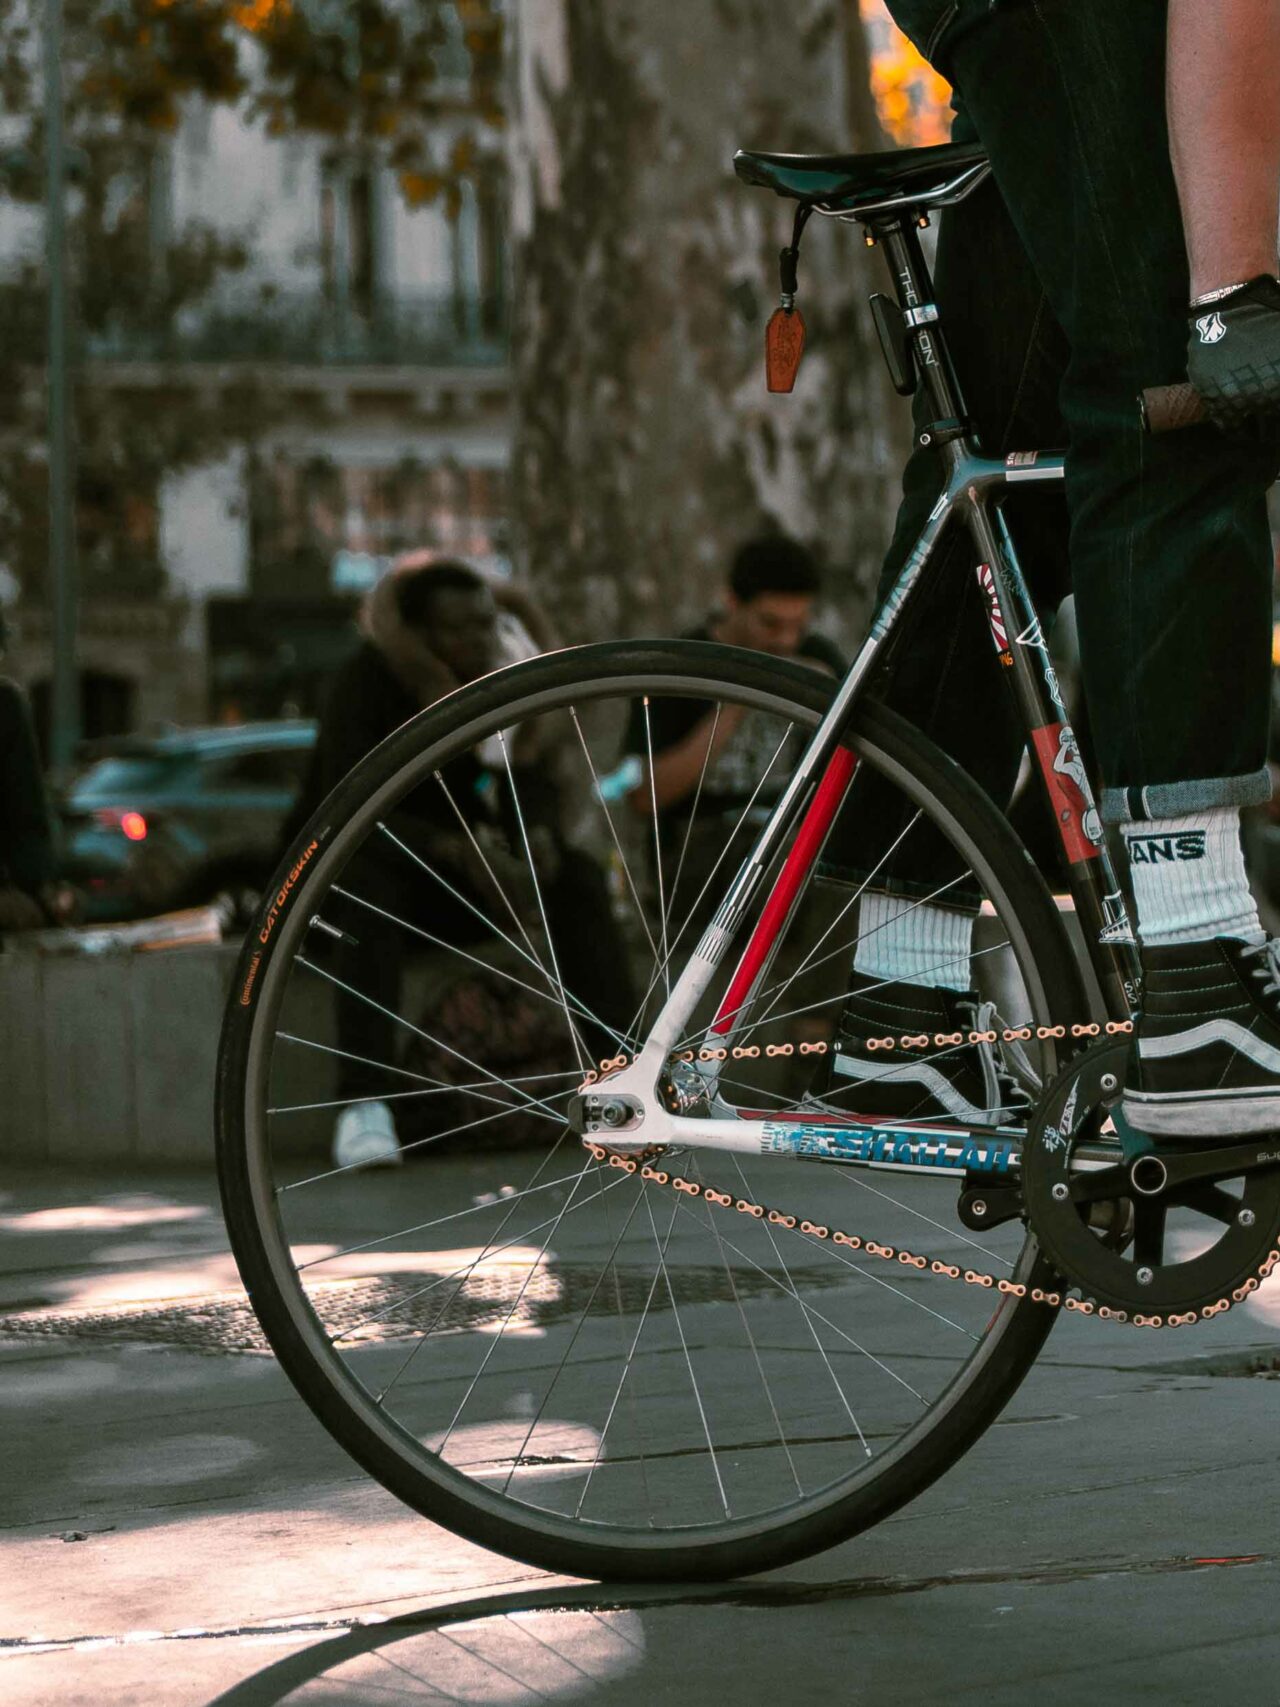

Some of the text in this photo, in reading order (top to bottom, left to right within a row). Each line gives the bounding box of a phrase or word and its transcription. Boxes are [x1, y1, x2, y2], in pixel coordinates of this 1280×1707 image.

[1127, 830, 1206, 865] ANS
[259, 839, 319, 943] GATORSKIN
[240, 954, 261, 1006] Continental
